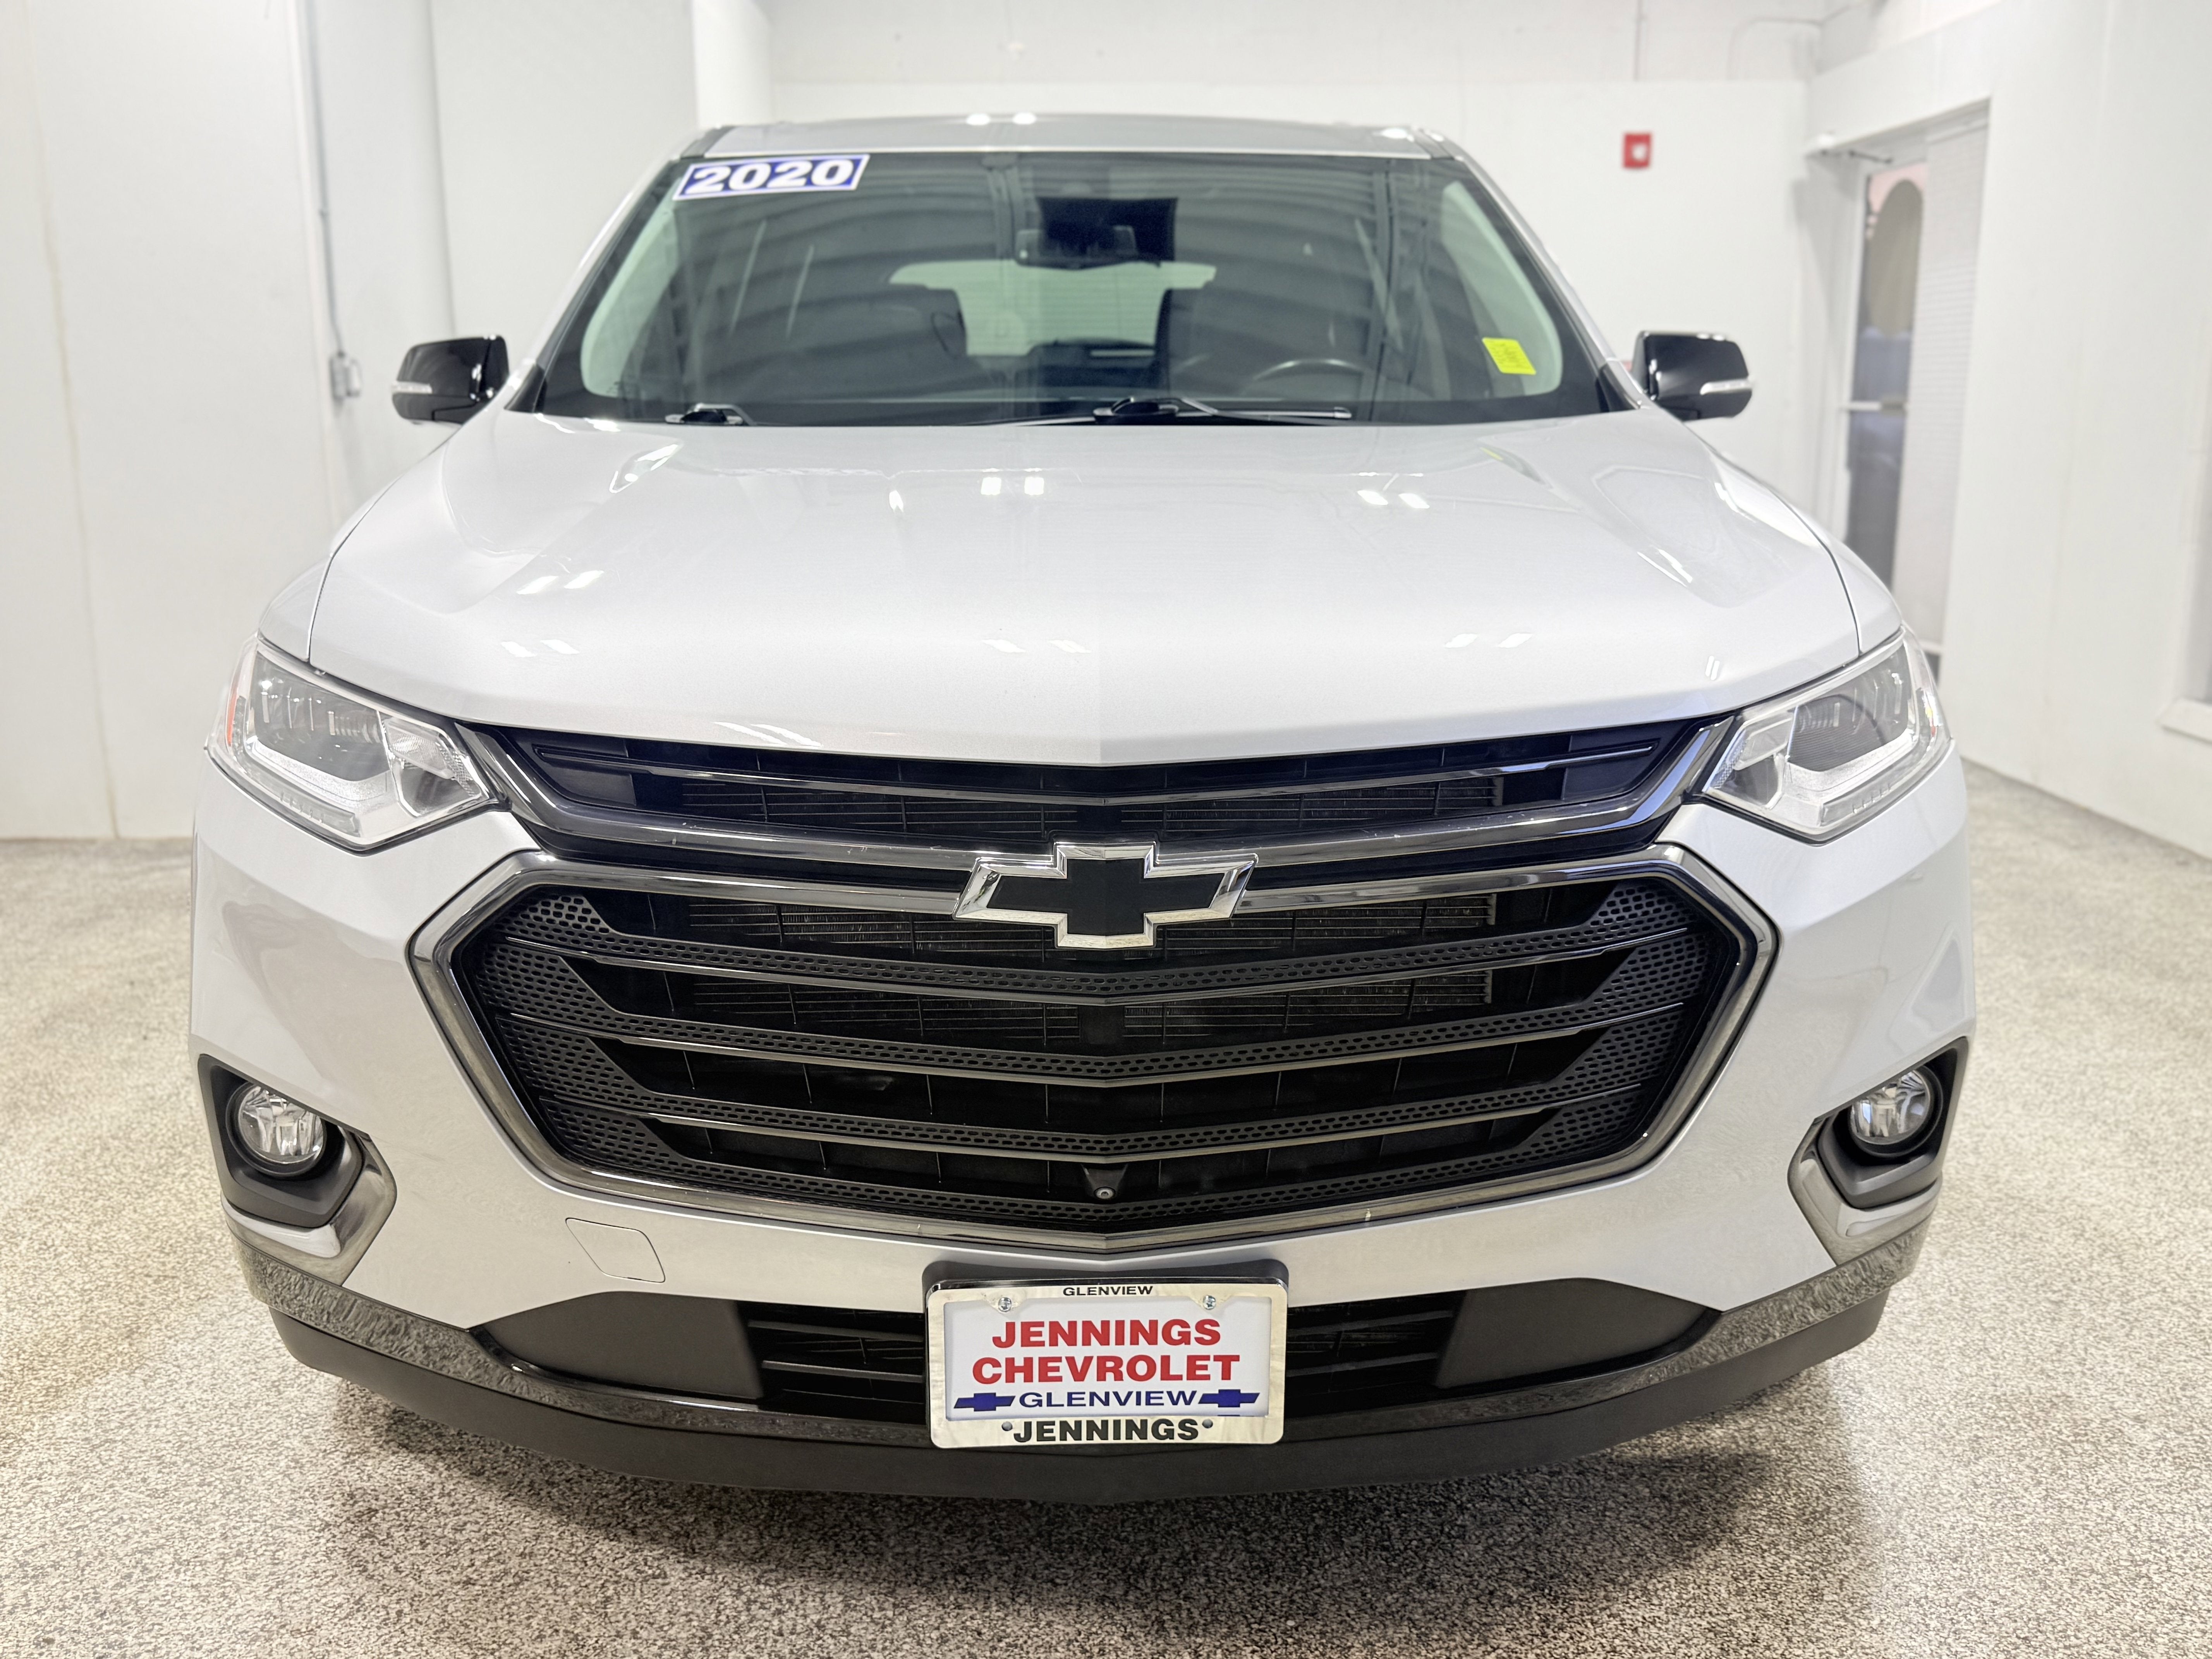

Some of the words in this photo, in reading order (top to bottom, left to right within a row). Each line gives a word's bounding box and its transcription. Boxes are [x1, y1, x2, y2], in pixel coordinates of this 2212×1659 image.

[684, 159, 854, 194] 2020
[1062, 1286, 1153, 1296] GLENVIEW
[992, 1319, 1221, 1348] JENNINGS
[972, 1355, 1240, 1384] CHEVROLET
[1018, 1390, 1197, 1408] GLENVIEW
[1013, 1419, 1199, 1443] JENNINGS
